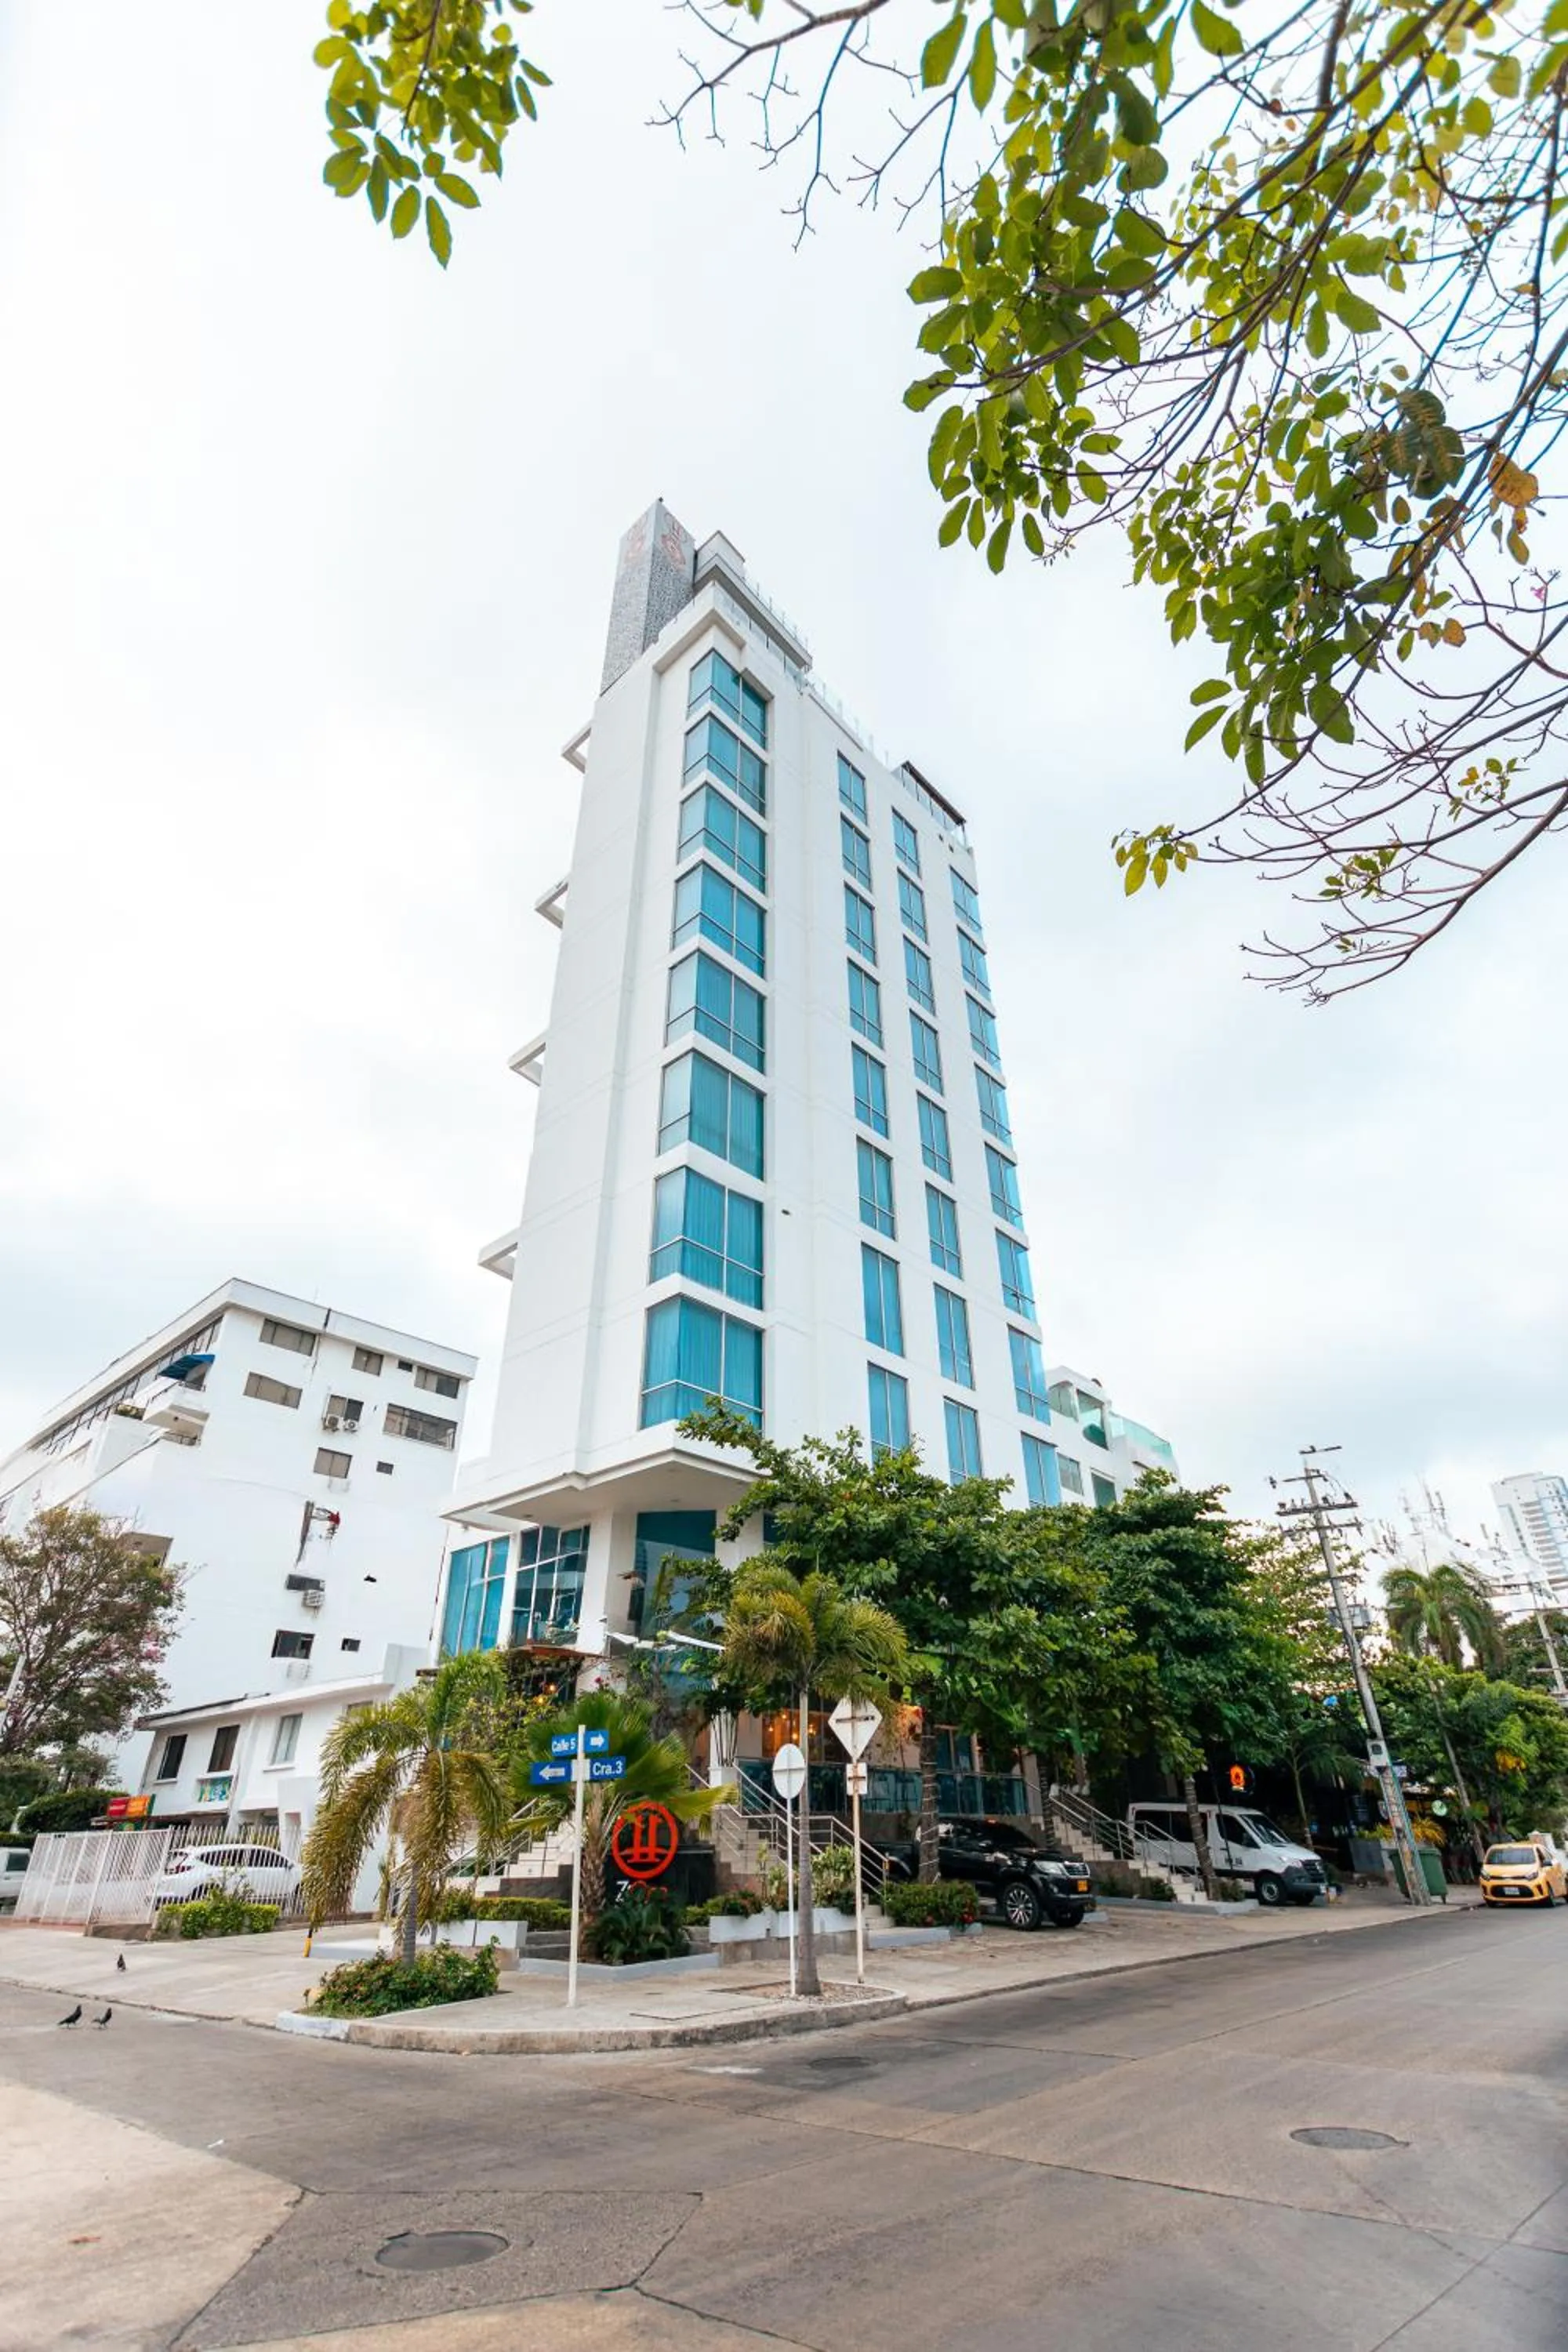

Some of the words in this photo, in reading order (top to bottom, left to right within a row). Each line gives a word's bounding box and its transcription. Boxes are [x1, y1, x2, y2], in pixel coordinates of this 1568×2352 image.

[551, 1739, 570, 1752] Calle
[570, 1737, 576, 1750] 5
[592, 1760, 622, 1776] Cra.3
